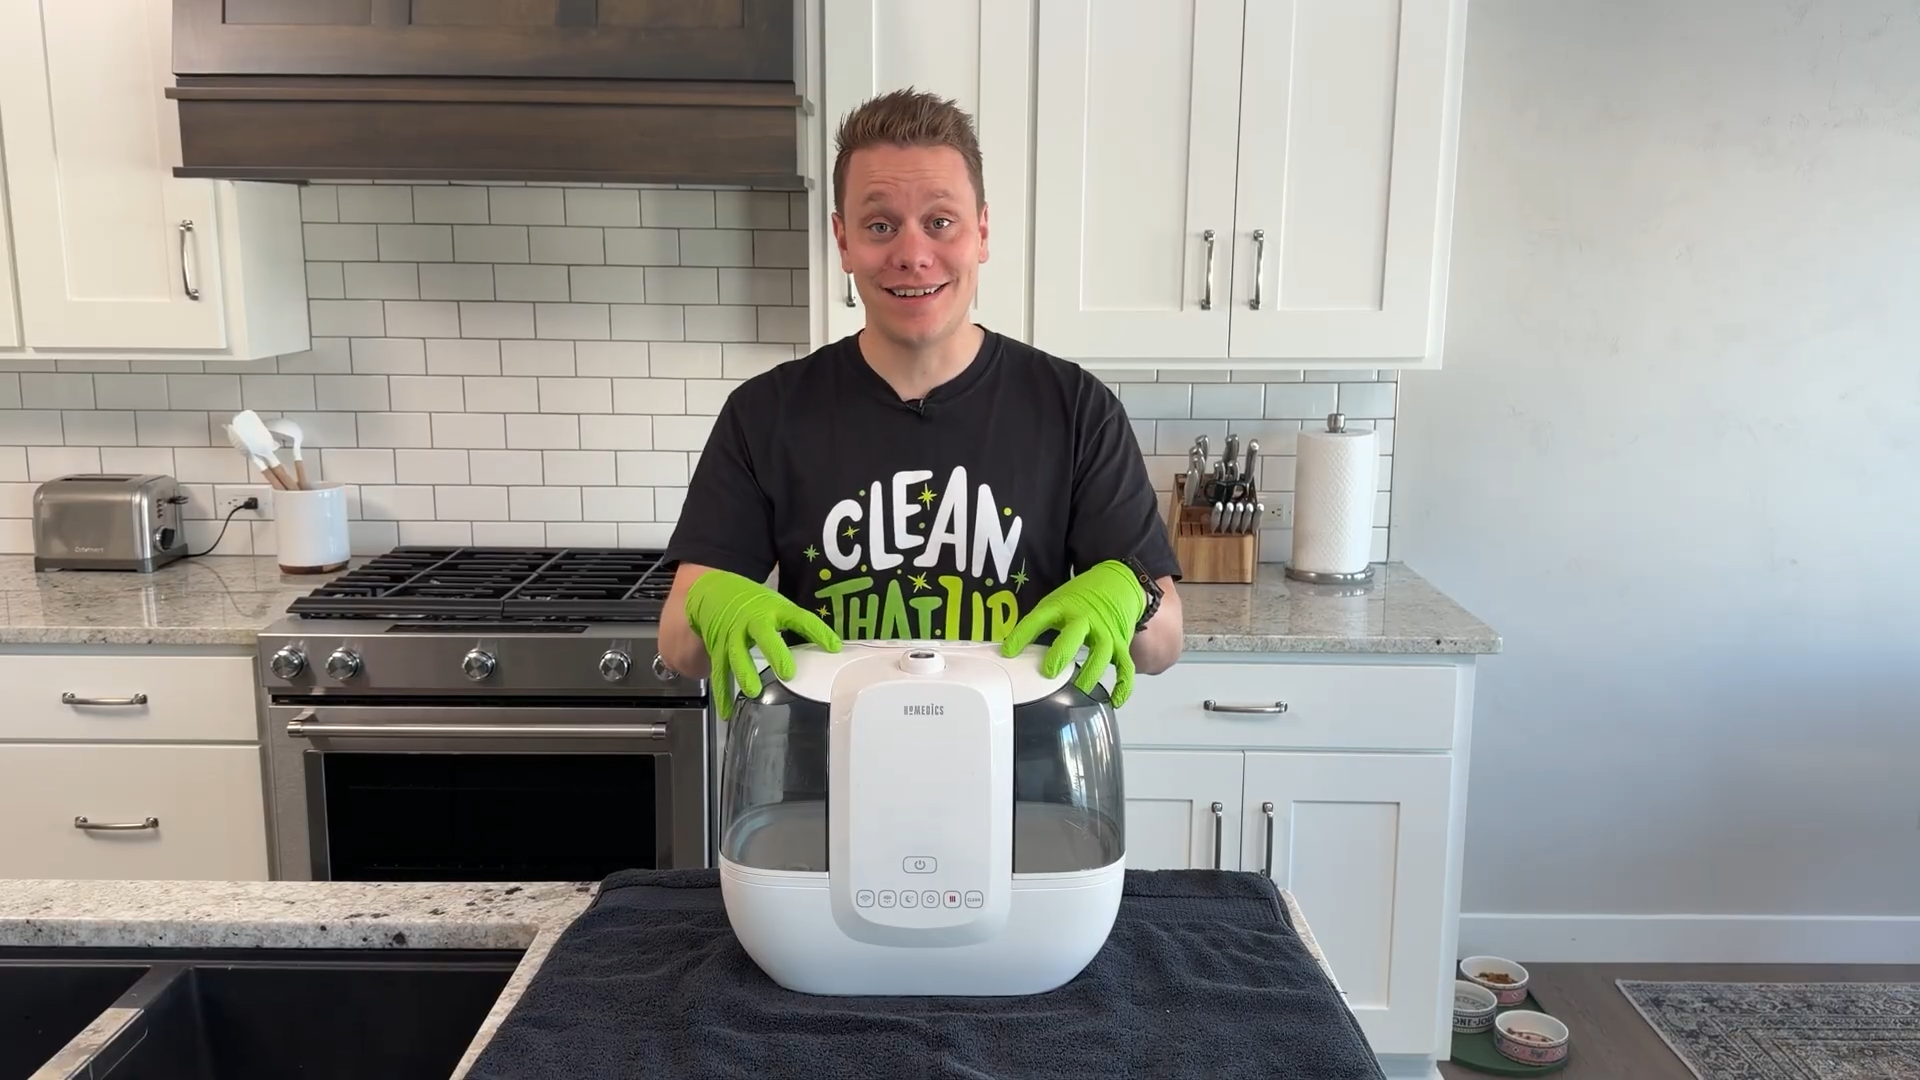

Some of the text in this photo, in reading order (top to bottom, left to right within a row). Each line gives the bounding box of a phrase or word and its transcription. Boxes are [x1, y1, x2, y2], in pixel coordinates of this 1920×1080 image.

[822, 465, 1022, 584] CLEAN
[814, 575, 1019, 642] THAT UP
[903, 703, 944, 716] HOMEDICS
